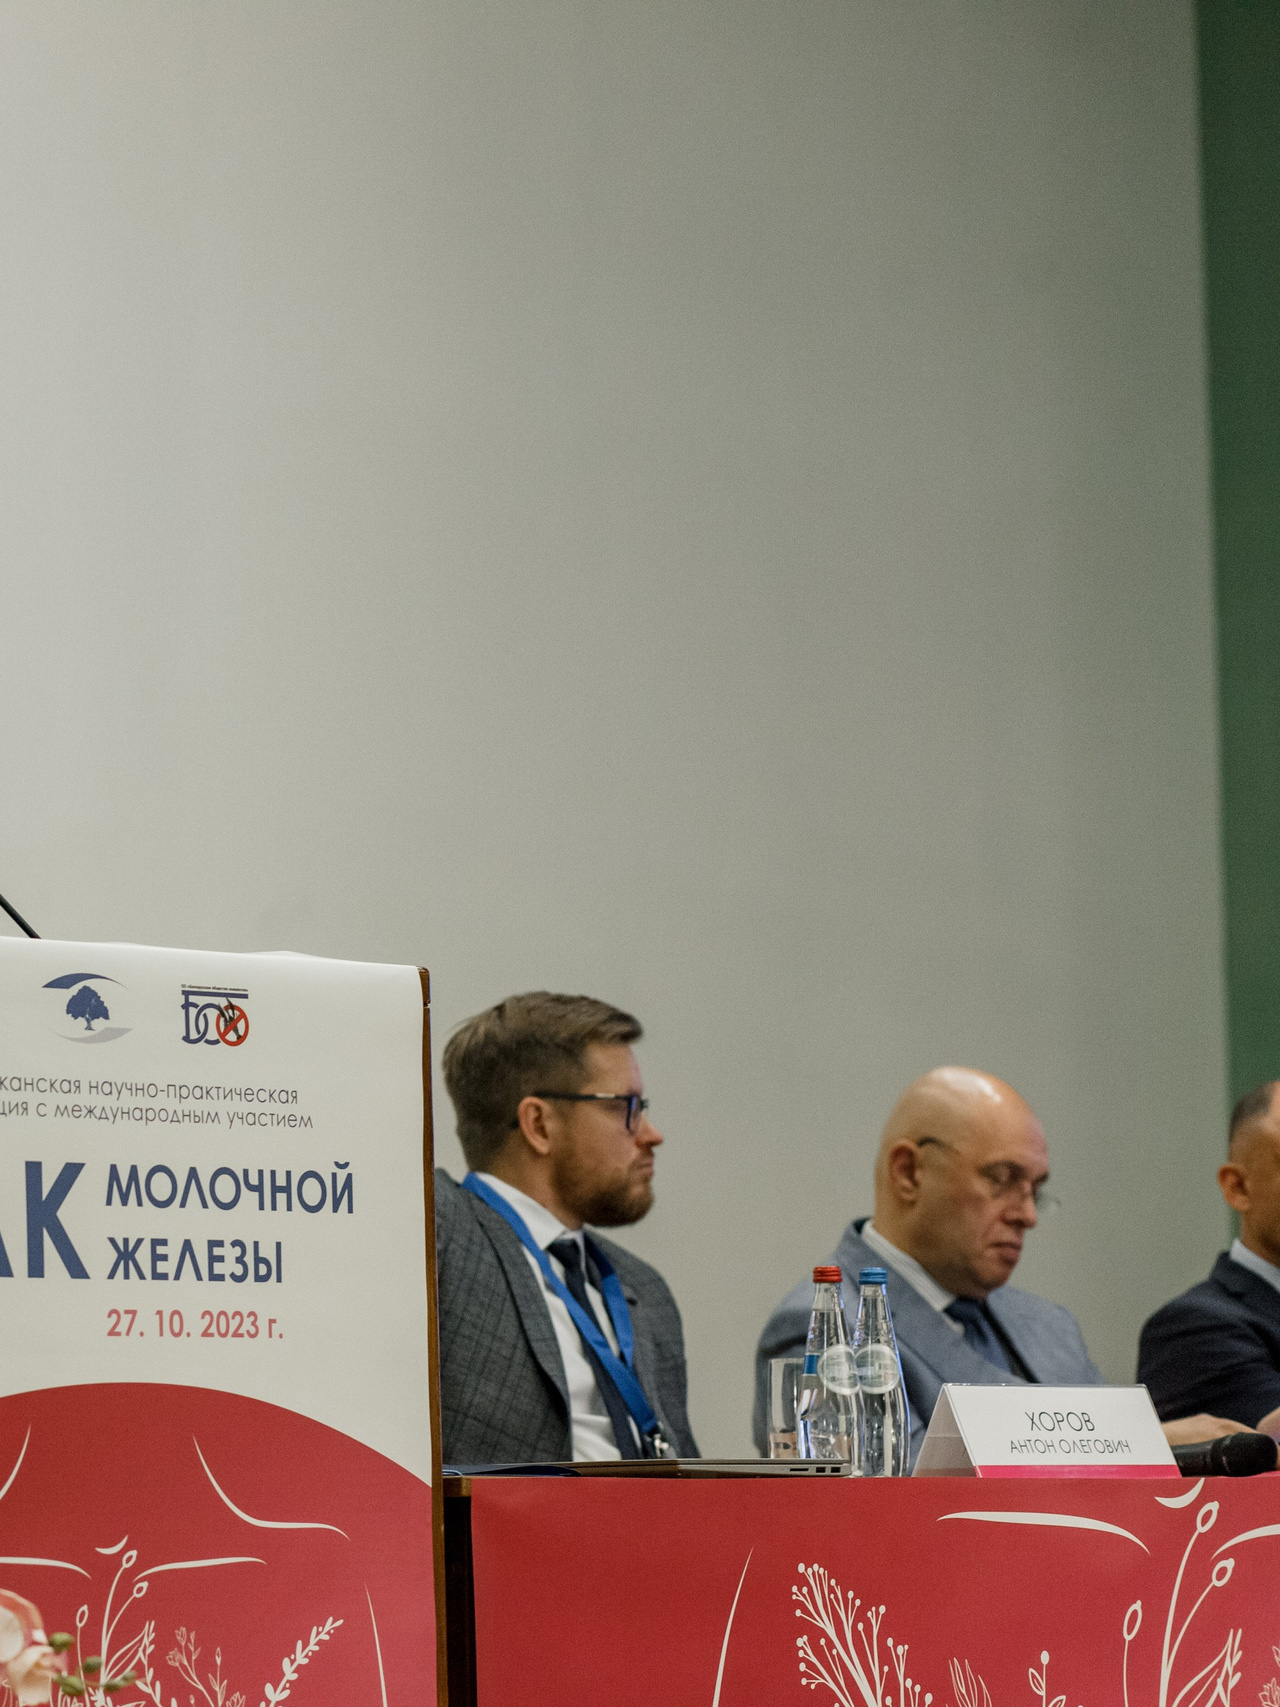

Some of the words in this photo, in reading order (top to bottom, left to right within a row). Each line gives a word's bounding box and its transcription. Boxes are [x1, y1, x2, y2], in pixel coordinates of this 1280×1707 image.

[88, 1080, 299, 1105] научно-практическая
[35, 1102, 48, 1118] с
[54, 1103, 221, 1127] международным
[226, 1111, 314, 1130] участием
[105, 1160, 355, 1215] МОЛОЧНОЙ
[106, 1236, 283, 1284] ЖЕЛЕЗЫ
[106, 1308, 146, 1338] 27.
[154, 1309, 192, 1338] 10.
[200, 1309, 261, 1339] 2023
[267, 1318, 285, 1339] г.
[1024, 1411, 1095, 1432] ХОРОВ
[1010, 1438, 1057, 1454] АНТОН
[1058, 1438, 1132, 1454] ОЛЕГОВИЧ
